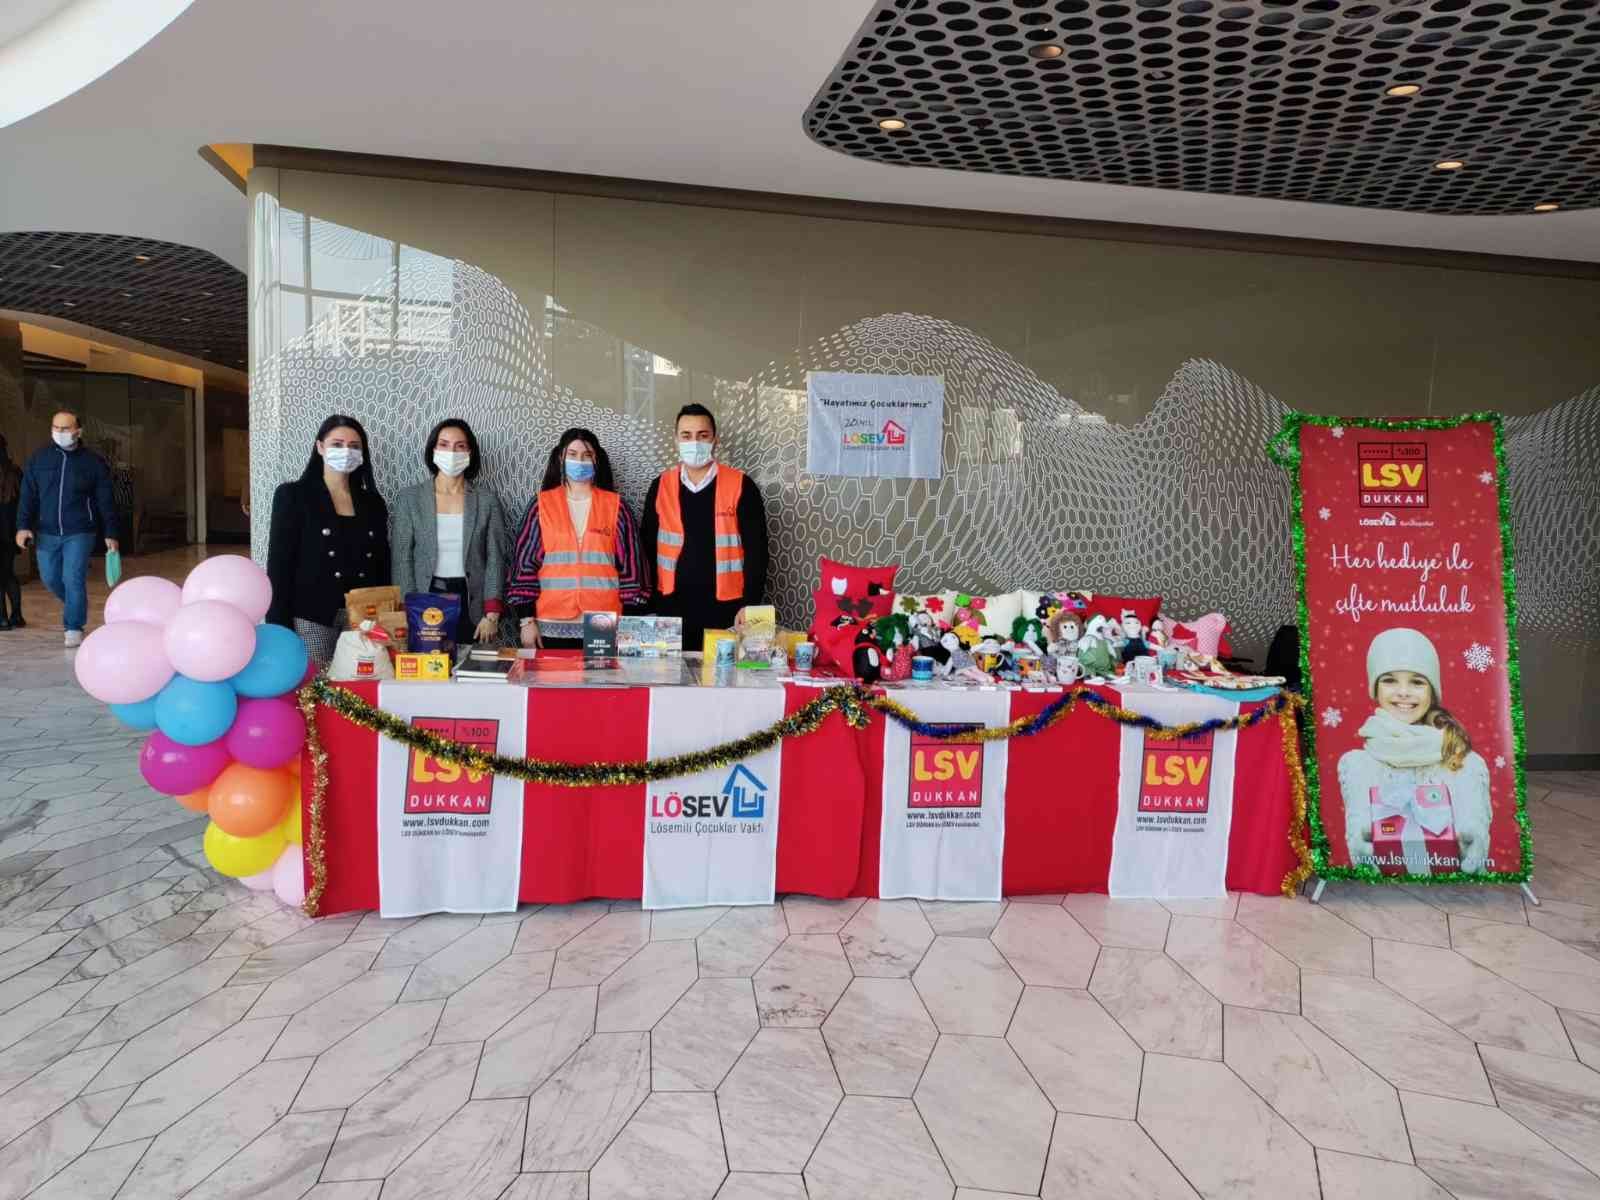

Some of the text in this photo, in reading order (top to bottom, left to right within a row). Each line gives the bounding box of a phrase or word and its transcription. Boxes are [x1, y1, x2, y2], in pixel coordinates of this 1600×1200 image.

[1362, 463, 1424, 487] LSV
[1330, 541, 1474, 583] Her hediye ile
[1335, 583, 1476, 622] çifte mutluluk
[914, 750, 979, 781] LSV
[1145, 754, 1209, 786] LSV
[410, 794, 487, 808] DUKKAN
[912, 791, 978, 802] DUKKAN
[1142, 795, 1205, 808] DUKKAN
[651, 791, 729, 818] LÖSEV
[402, 816, 490, 829] www.lsvdukkan.com
[906, 810, 982, 820] www.lsvdukkan.com
[1136, 814, 1207, 825] www.lsvdukkan.com
[650, 822, 692, 834] Lösemili
[695, 822, 737, 837] Çocuklar
